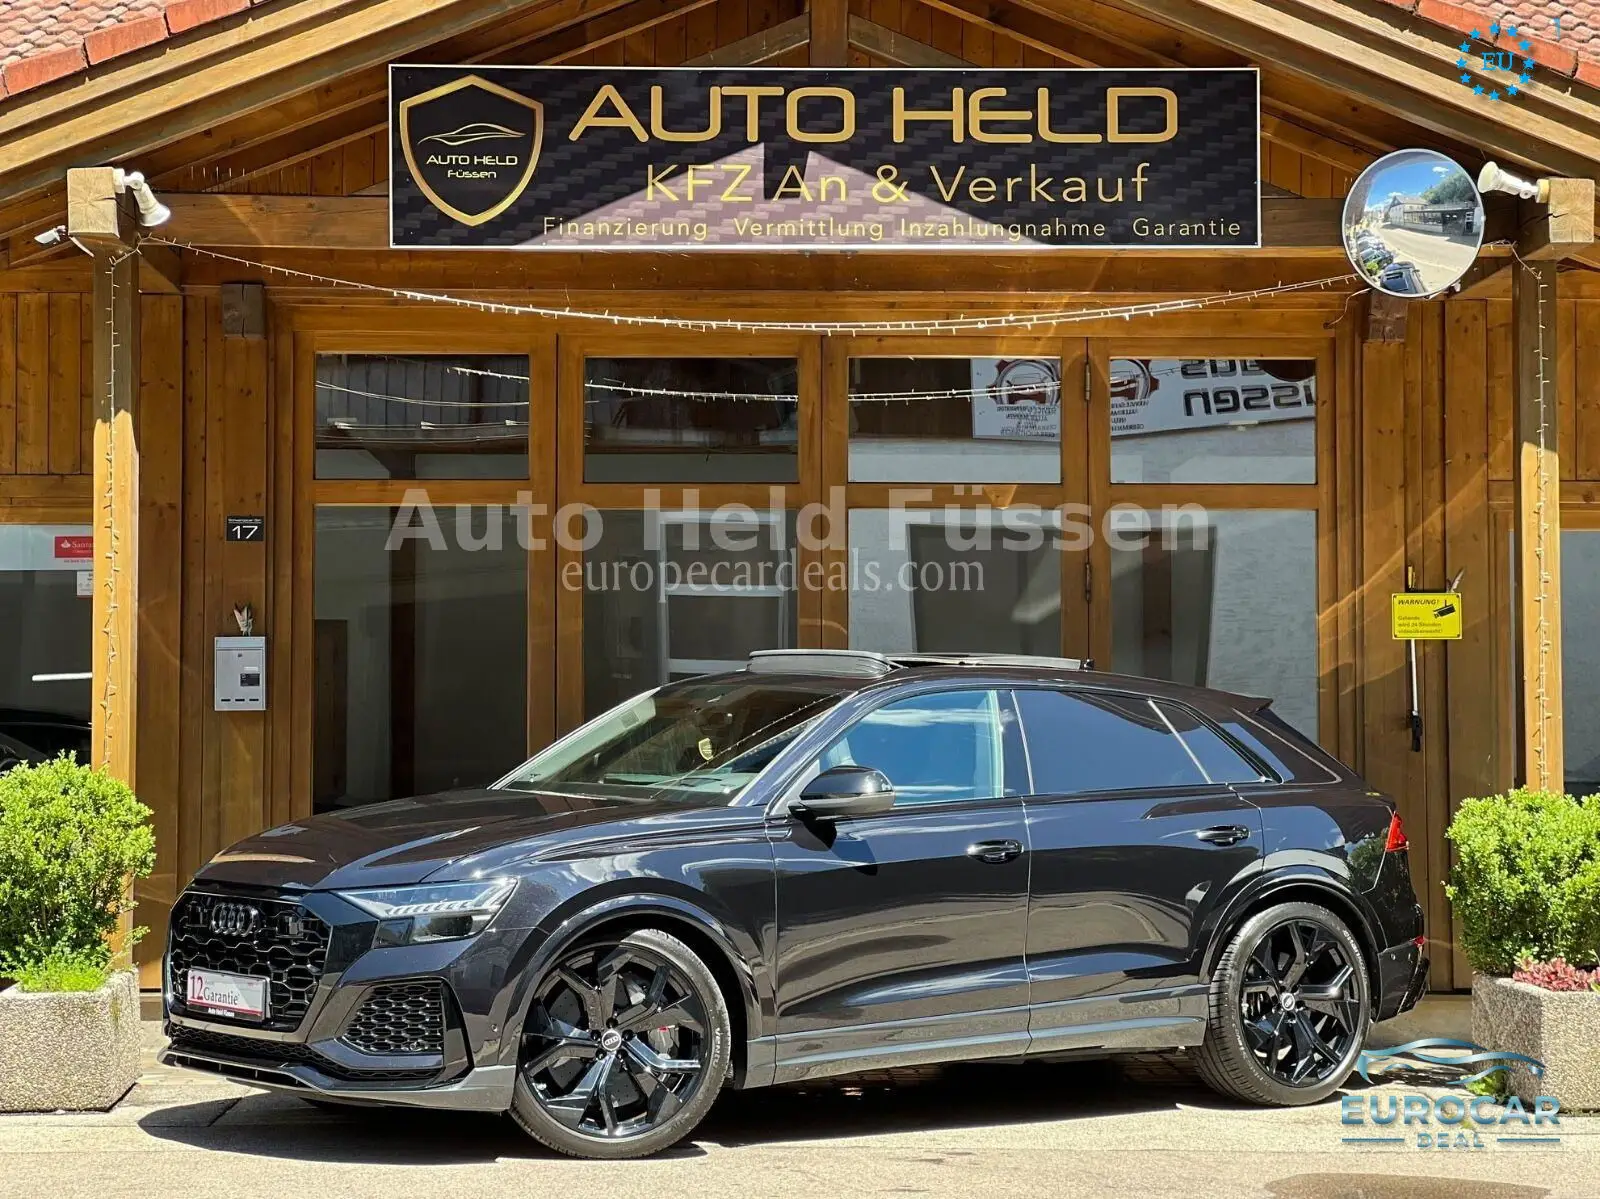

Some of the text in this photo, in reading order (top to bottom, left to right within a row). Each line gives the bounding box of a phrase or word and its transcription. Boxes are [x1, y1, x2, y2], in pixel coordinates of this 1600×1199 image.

[568, 84, 1179, 144] AUTO HELD
[426, 154, 518, 166] AUTO HELD
[447, 169, 497, 179] Füssen
[646, 162, 1151, 203] KFZ An & Verkauf
[543, 217, 1242, 241] Finanzierung Vermittlung Inzahlungnahme Garantie
[232, 525, 258, 539] 17
[190, 975, 238, 1006] 12 Garantie
